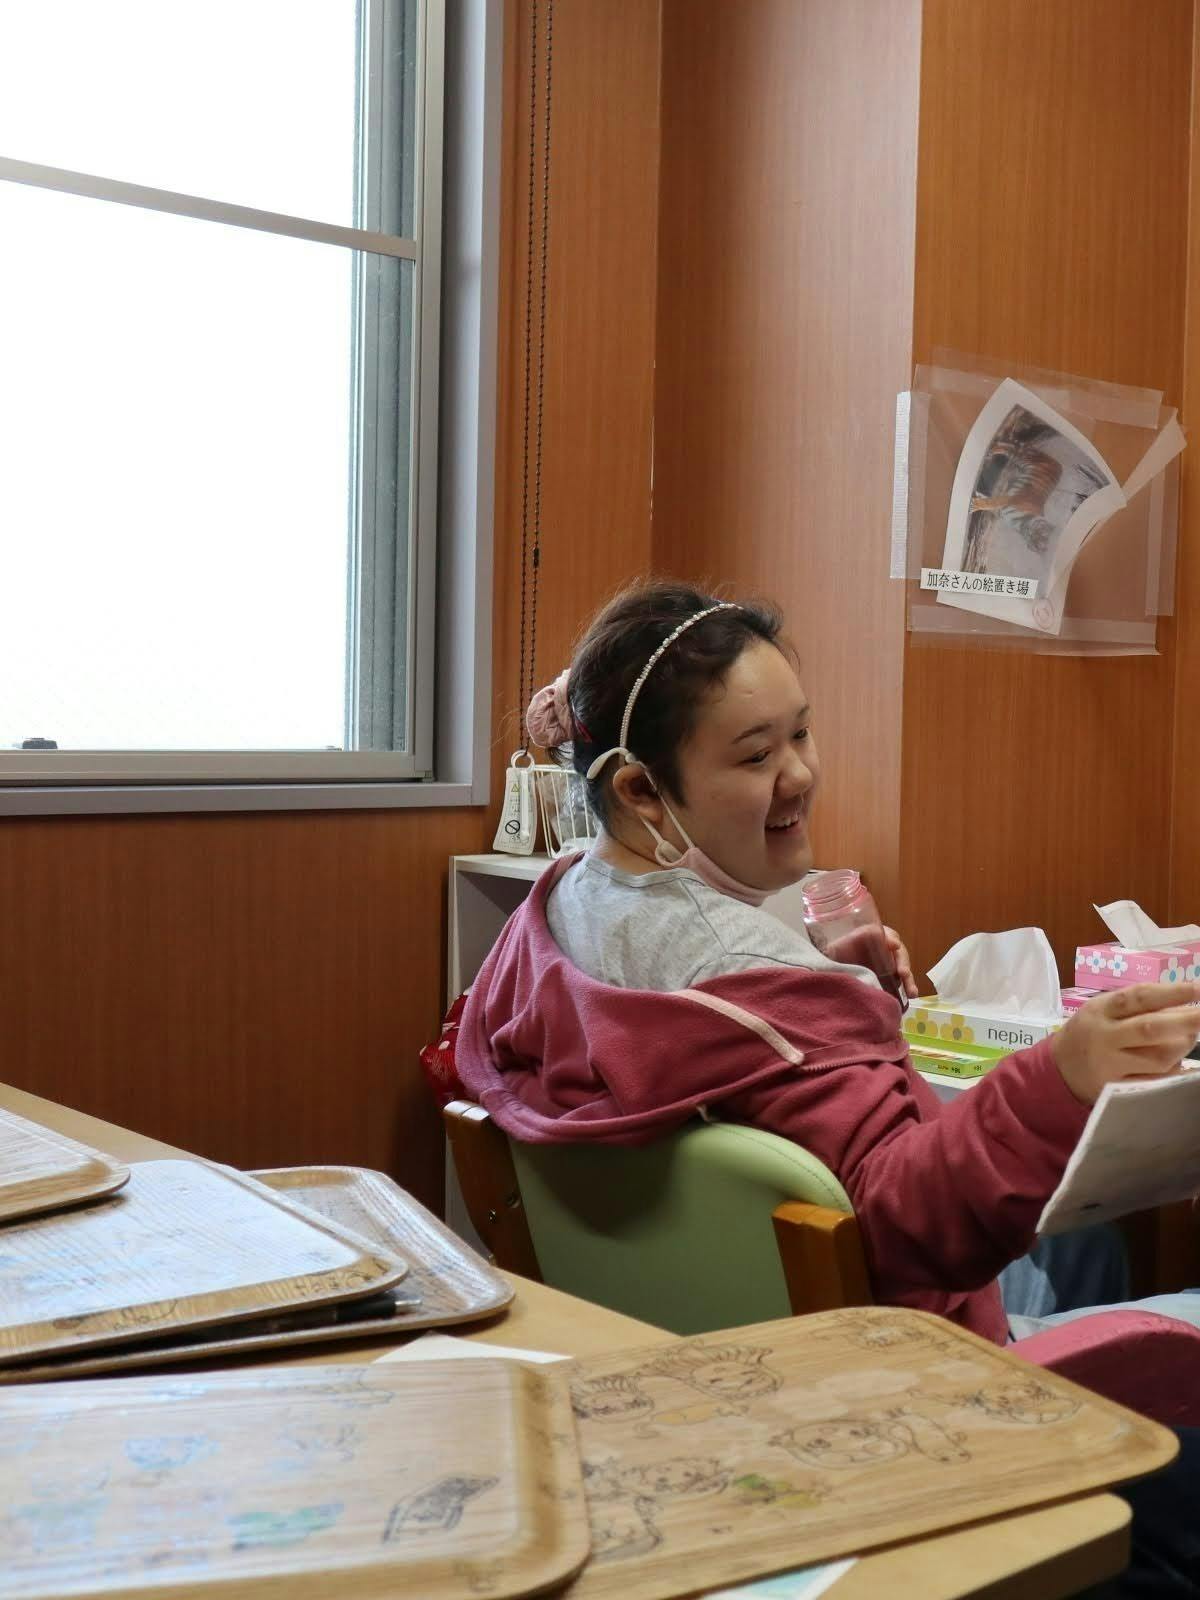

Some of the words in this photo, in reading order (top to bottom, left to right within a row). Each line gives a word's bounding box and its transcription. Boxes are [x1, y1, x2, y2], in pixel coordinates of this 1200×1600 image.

[926, 571, 1030, 596] 加奈さんの絵置き場
[987, 1027, 1034, 1046] nepia
